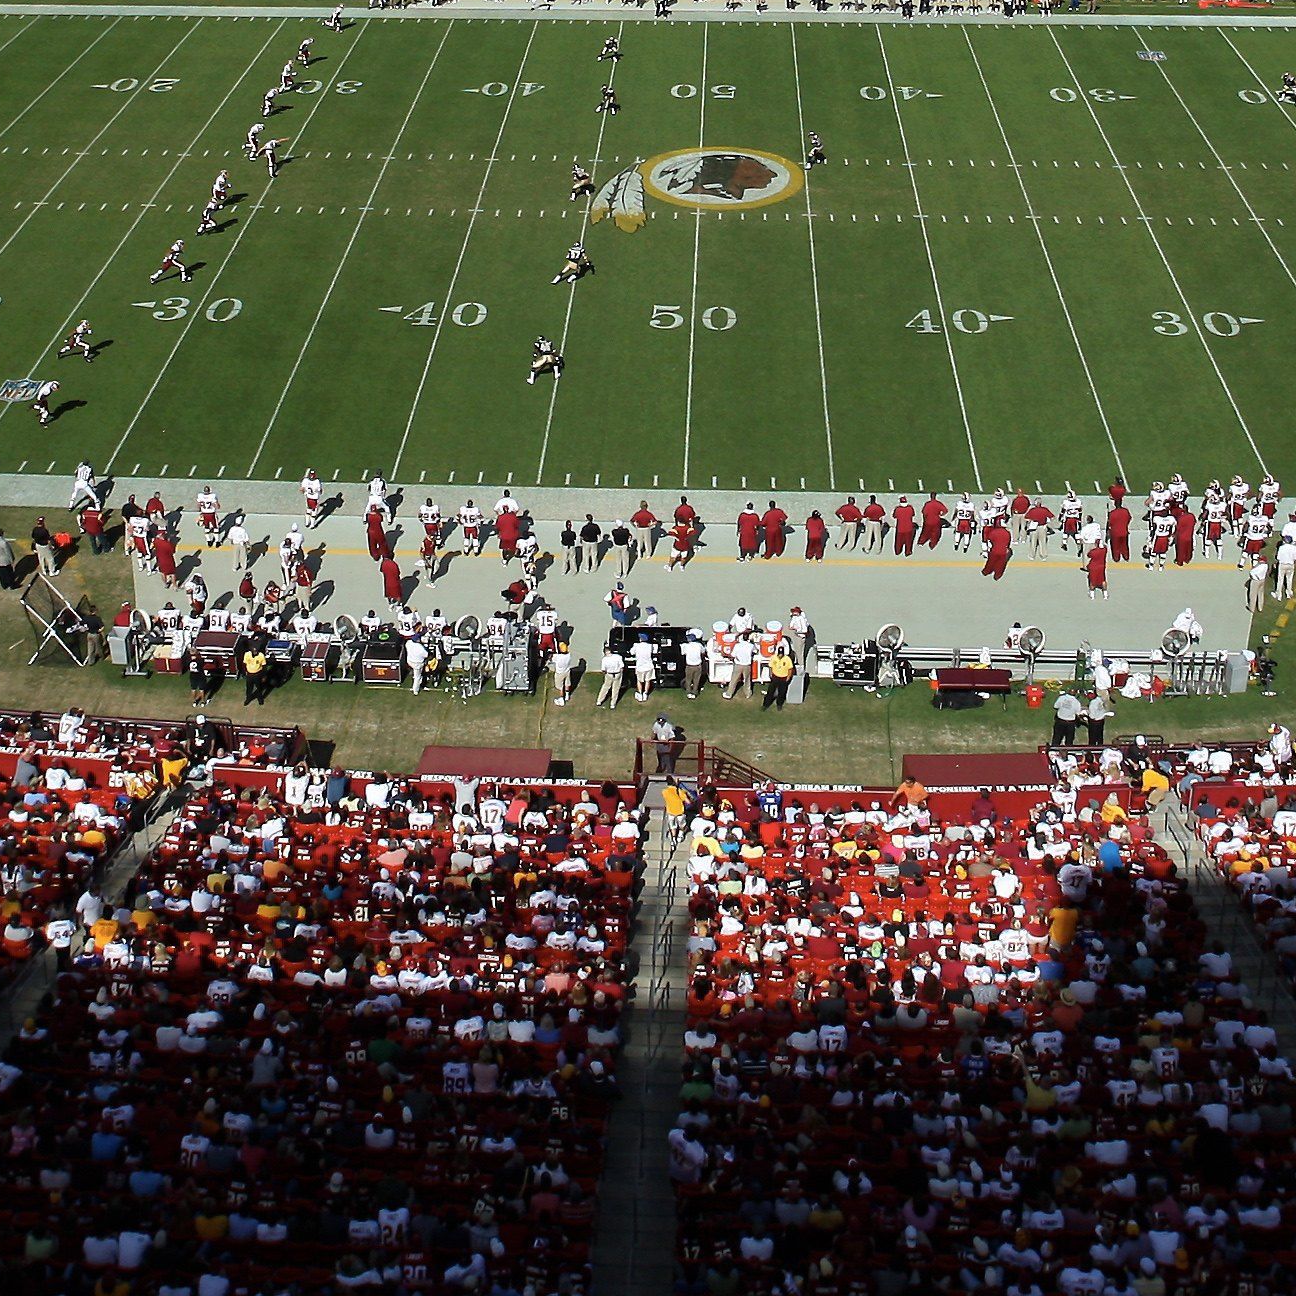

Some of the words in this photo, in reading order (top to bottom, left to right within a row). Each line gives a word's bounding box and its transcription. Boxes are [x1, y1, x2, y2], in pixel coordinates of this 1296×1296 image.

[670, 82, 737, 96] 50
[152, 297, 244, 321] 30
[402, 301, 488, 326] 40
[649, 304, 737, 331] 50
[904, 309, 988, 334] 40
[1151, 311, 1241, 336] 30
[794, 783, 829, 792] DREAM
